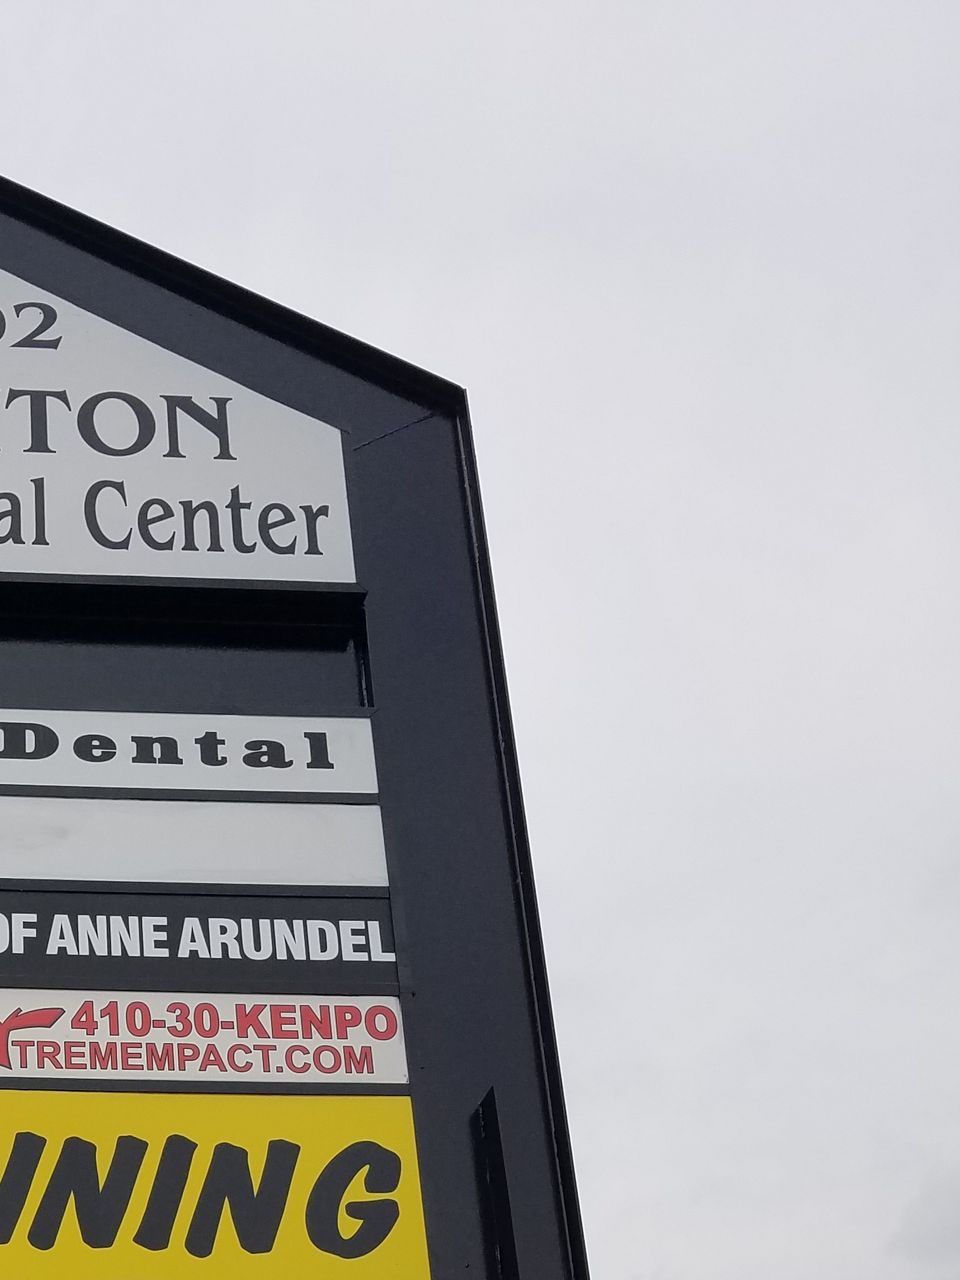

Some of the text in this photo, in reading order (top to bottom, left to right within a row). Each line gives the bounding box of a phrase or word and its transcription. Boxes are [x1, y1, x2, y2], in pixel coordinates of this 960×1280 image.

[83, 479, 330, 556] Center
[46, 914, 170, 958] ANNE
[177, 917, 396, 962] ARUNDEL
[70, 1000, 398, 1041] 410-30-KENPO
